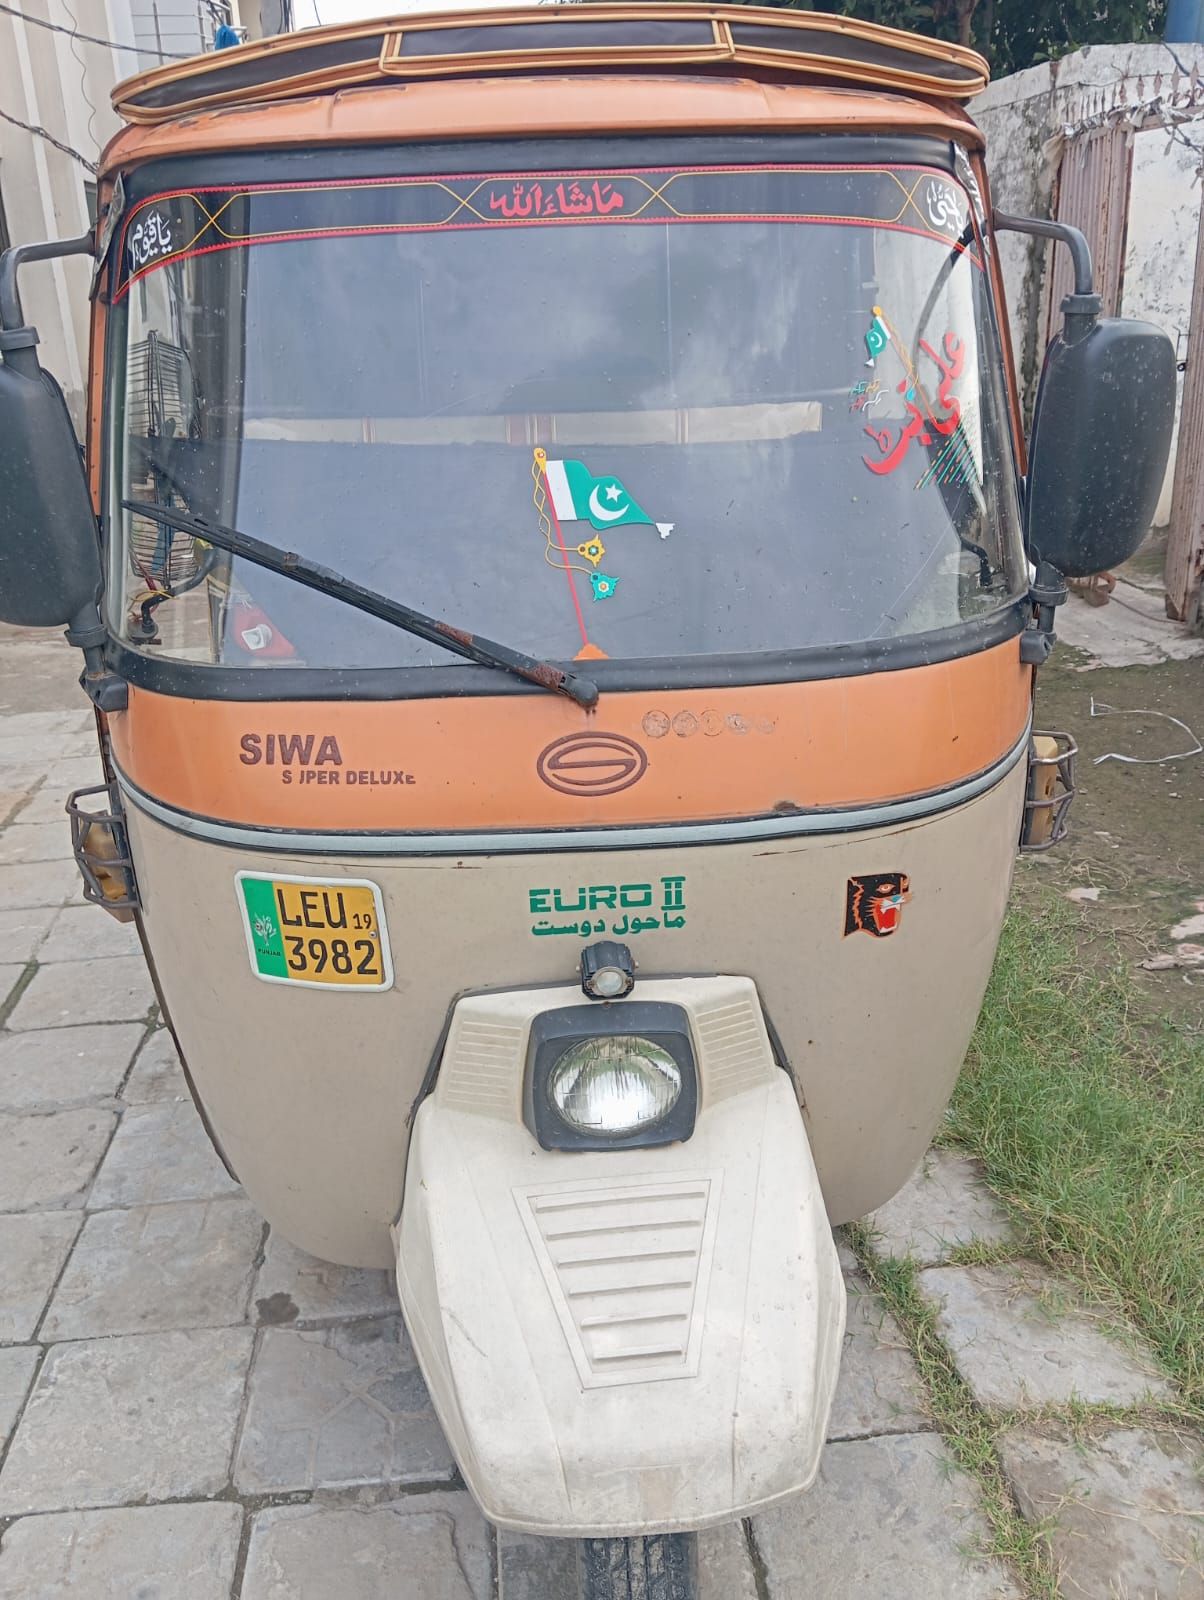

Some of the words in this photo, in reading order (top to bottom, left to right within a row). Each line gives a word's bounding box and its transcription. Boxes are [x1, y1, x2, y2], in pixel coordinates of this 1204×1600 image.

[239, 733, 343, 766] SIWA
[276, 889, 347, 929] LEU
[352, 913, 372, 930] 19
[529, 884, 652, 913] EURO
[660, 876, 686, 911] II
[531, 918, 606, 937] دوست
[284, 935, 378, 975] 3982
